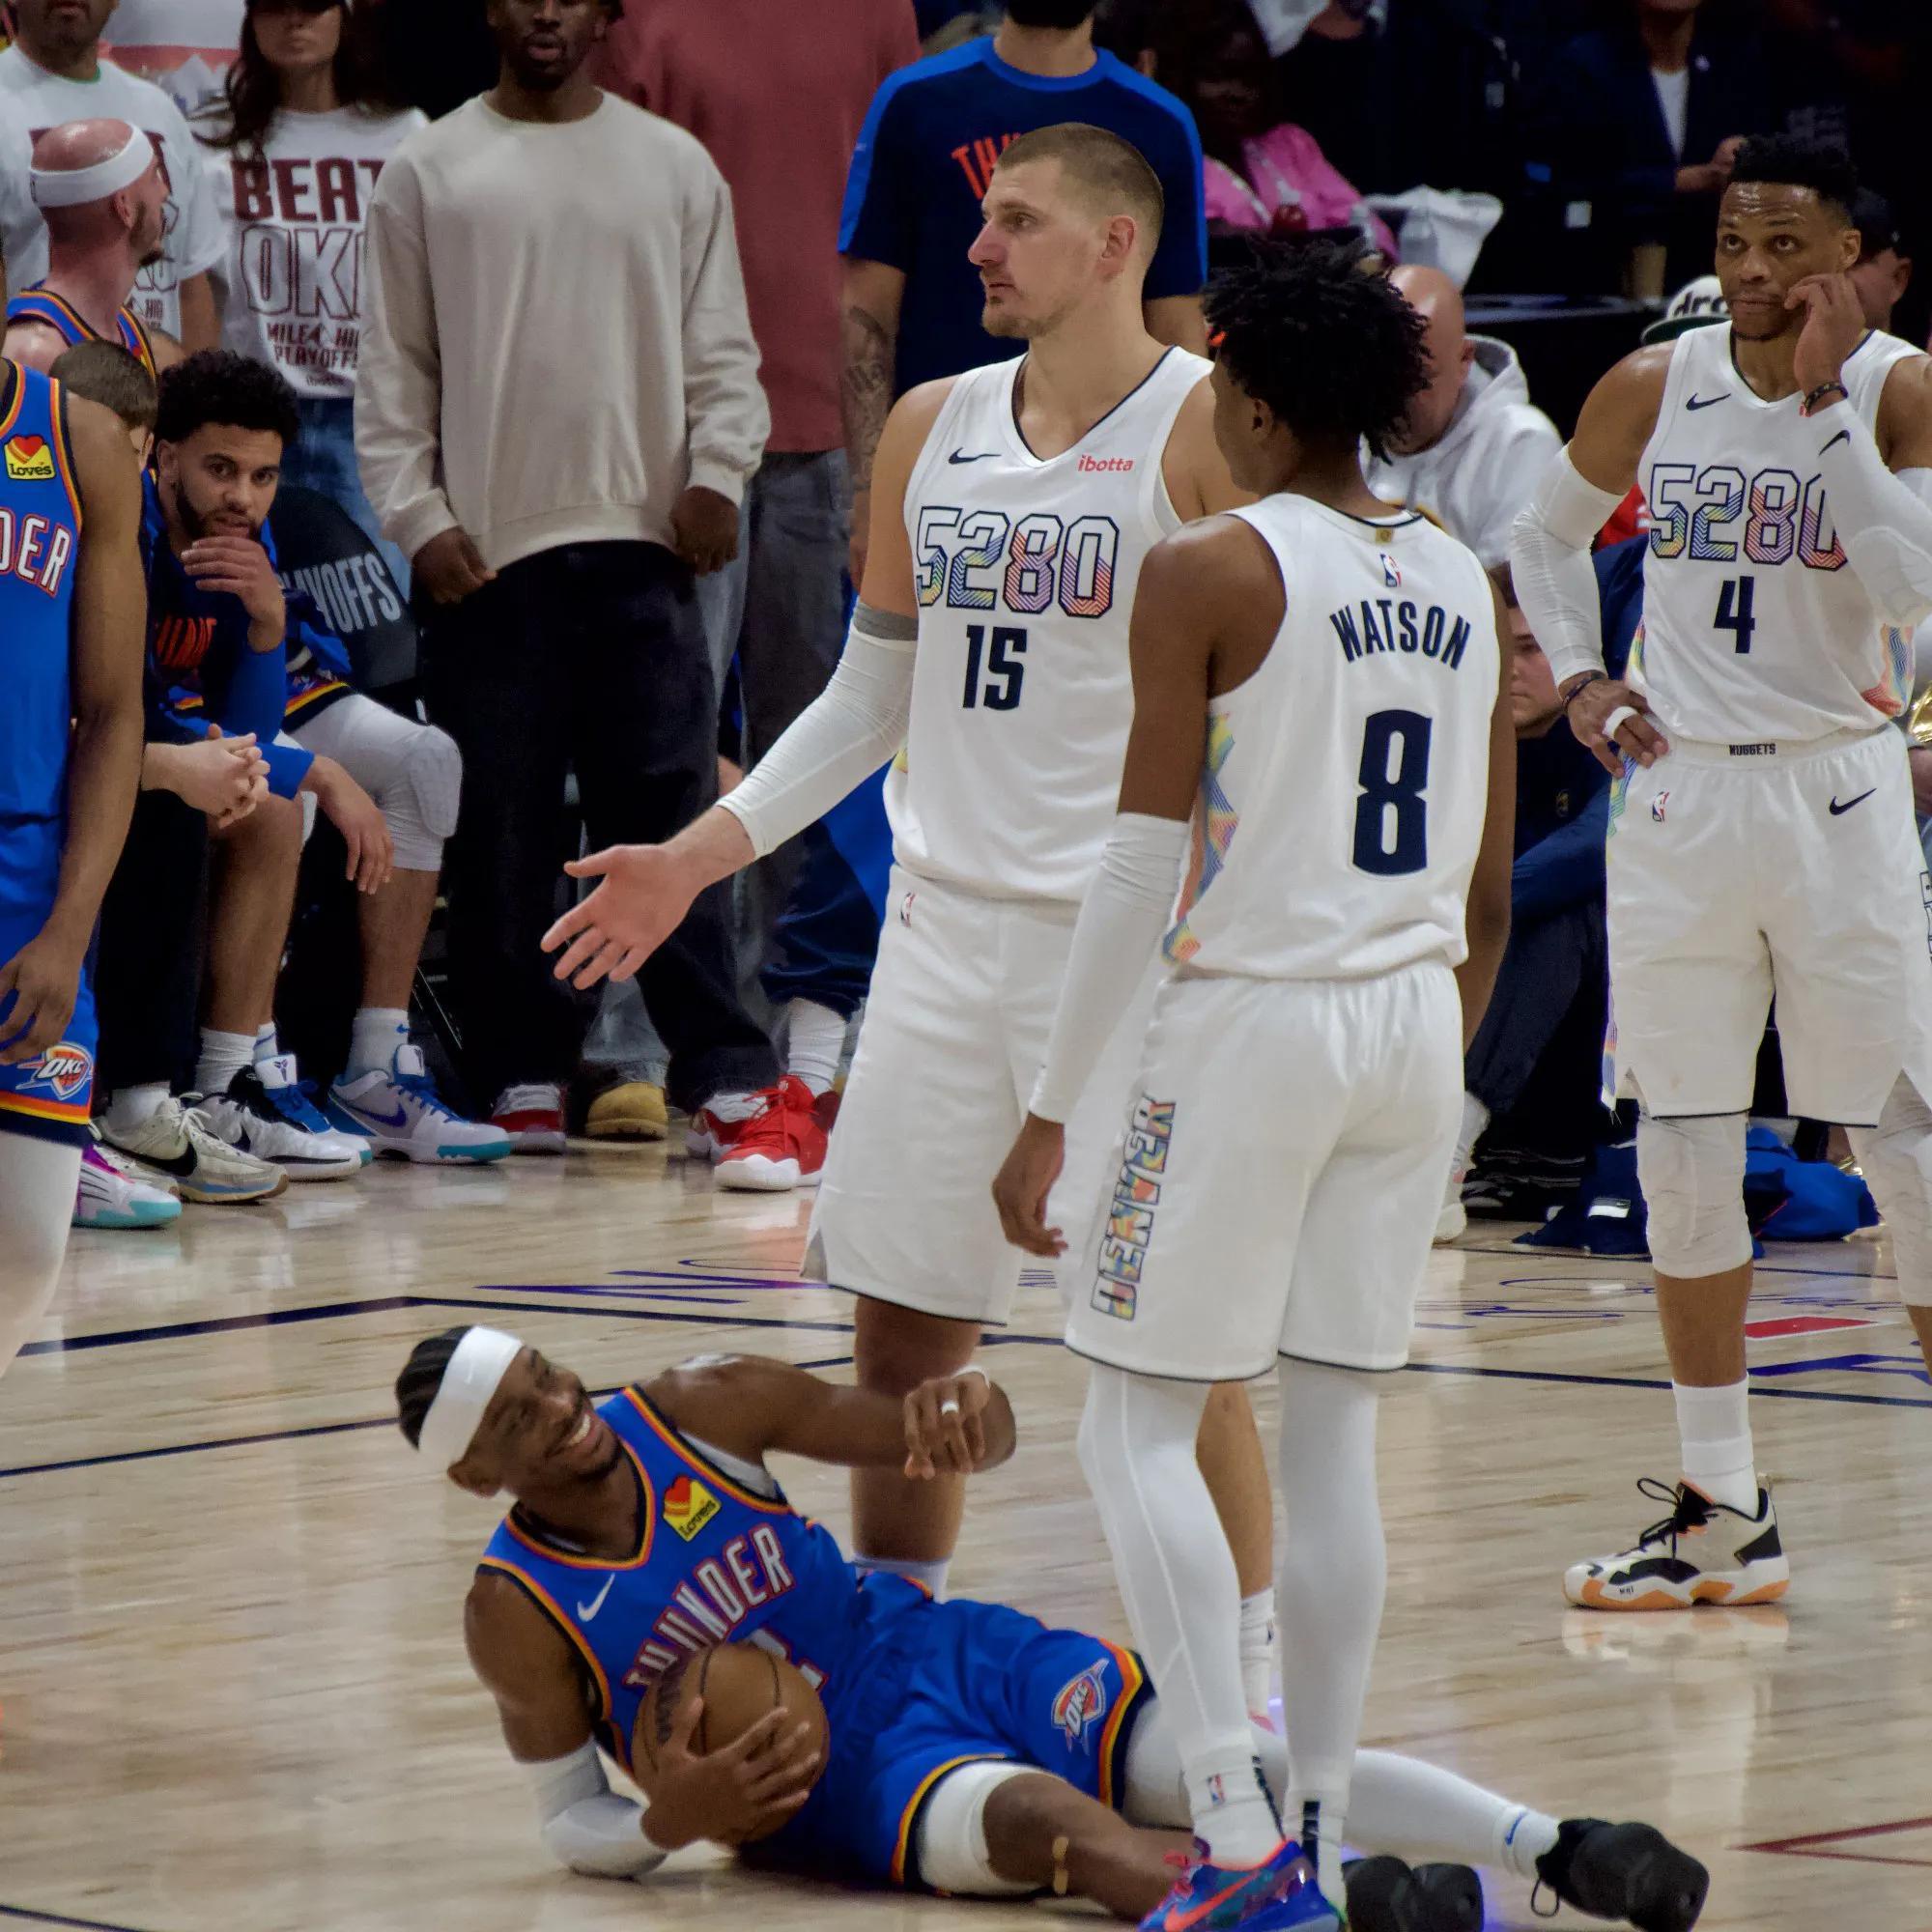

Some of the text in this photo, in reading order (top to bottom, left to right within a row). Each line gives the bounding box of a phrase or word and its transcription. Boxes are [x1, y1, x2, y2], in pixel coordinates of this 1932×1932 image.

[240, 223, 364, 321] OK
[335, 327, 359, 349] HI
[1077, 454, 1135, 473] ibotta
[1649, 464, 1848, 572] 5280
[277, 553, 401, 634] YOFFS
[917, 505, 1120, 619] 5280
[1329, 599, 1471, 671] WATSON
[1713, 575, 1756, 654] 4
[963, 625, 1028, 711] 15
[1728, 743, 1776, 756] NUGGETS
[1352, 709, 1433, 877] 8
